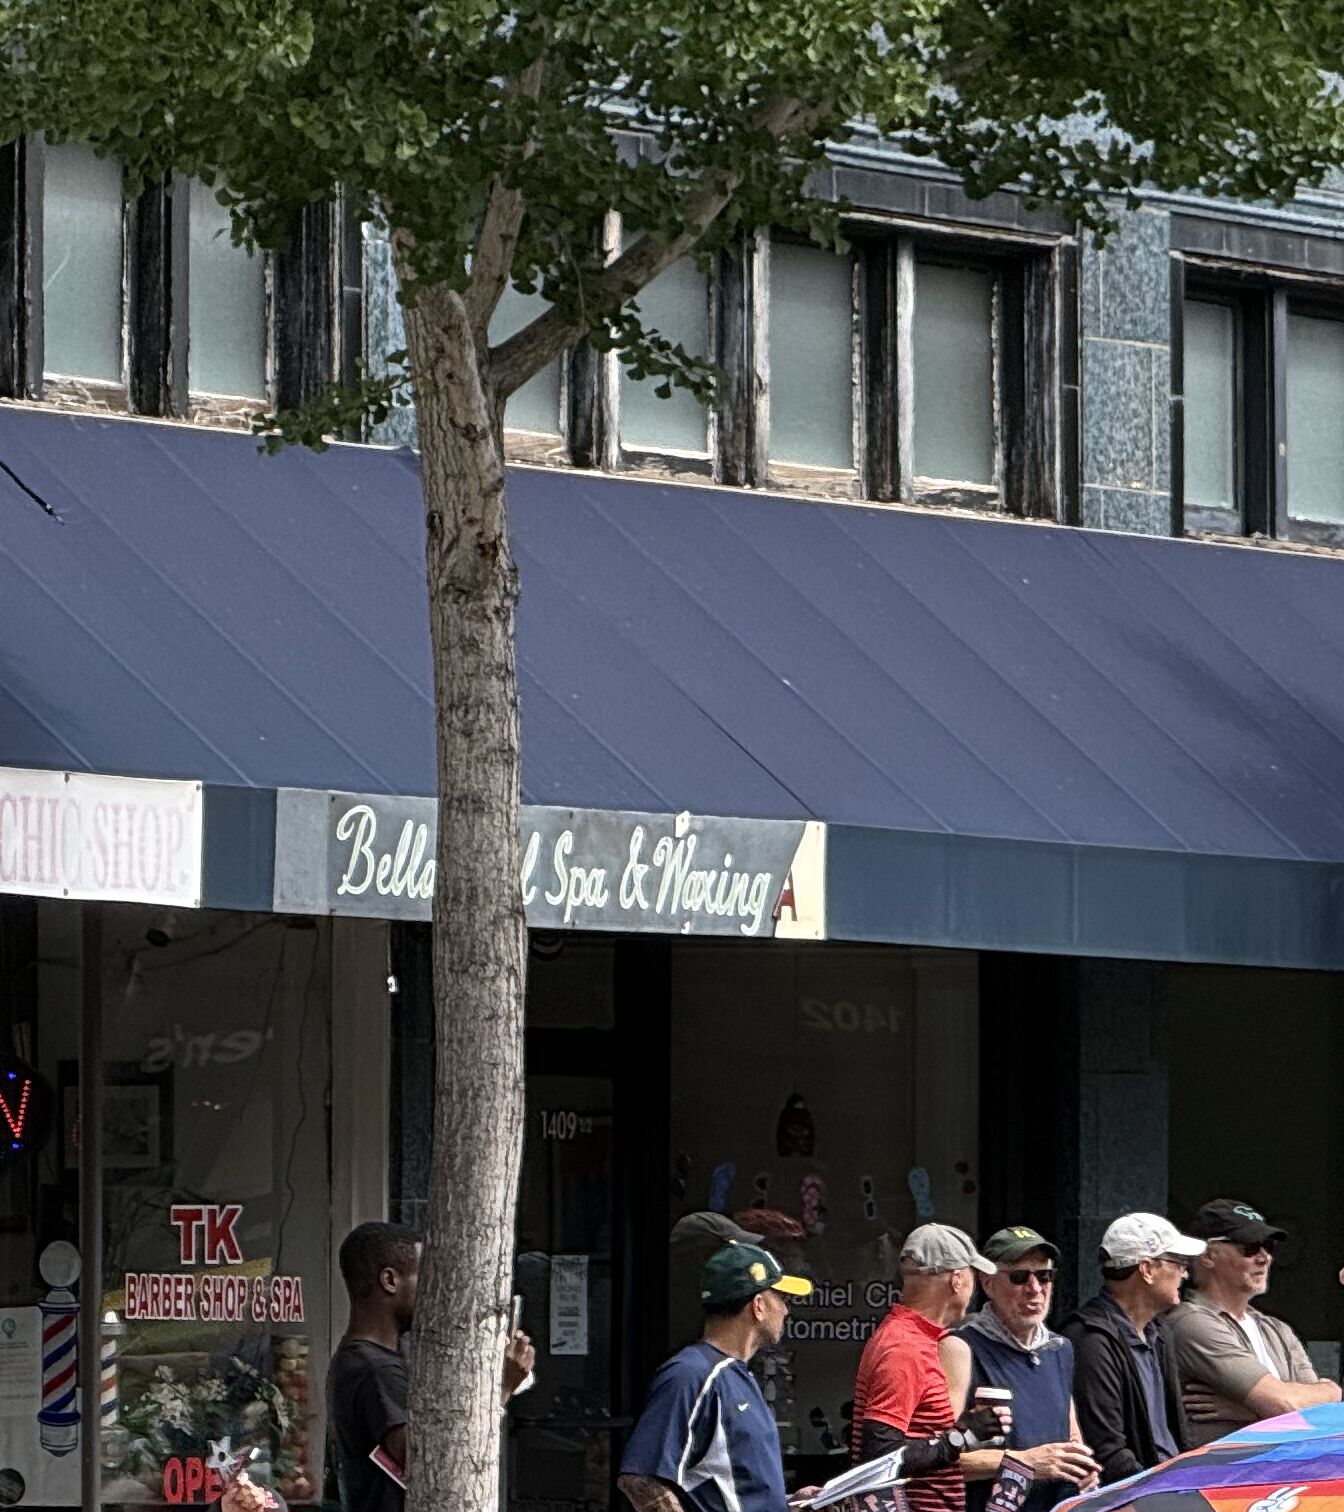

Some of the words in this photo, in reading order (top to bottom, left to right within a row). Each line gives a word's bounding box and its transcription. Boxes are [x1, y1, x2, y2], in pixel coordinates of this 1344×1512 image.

[336, 804, 437, 899] Bella
[545, 829, 608, 924] Spa
[619, 825, 650, 911] &
[653, 833, 772, 937] Waxing
[541, 1110, 577, 1140] 1409
[171, 1205, 243, 1265] TK
[125, 1273, 197, 1320] BARBER
[200, 1275, 249, 1321] SHOP
[253, 1276, 267, 1322] &
[270, 1276, 304, 1322] SPA
[790, 1281, 853, 1306] aniel
[163, 1456, 225, 1504] OPE
